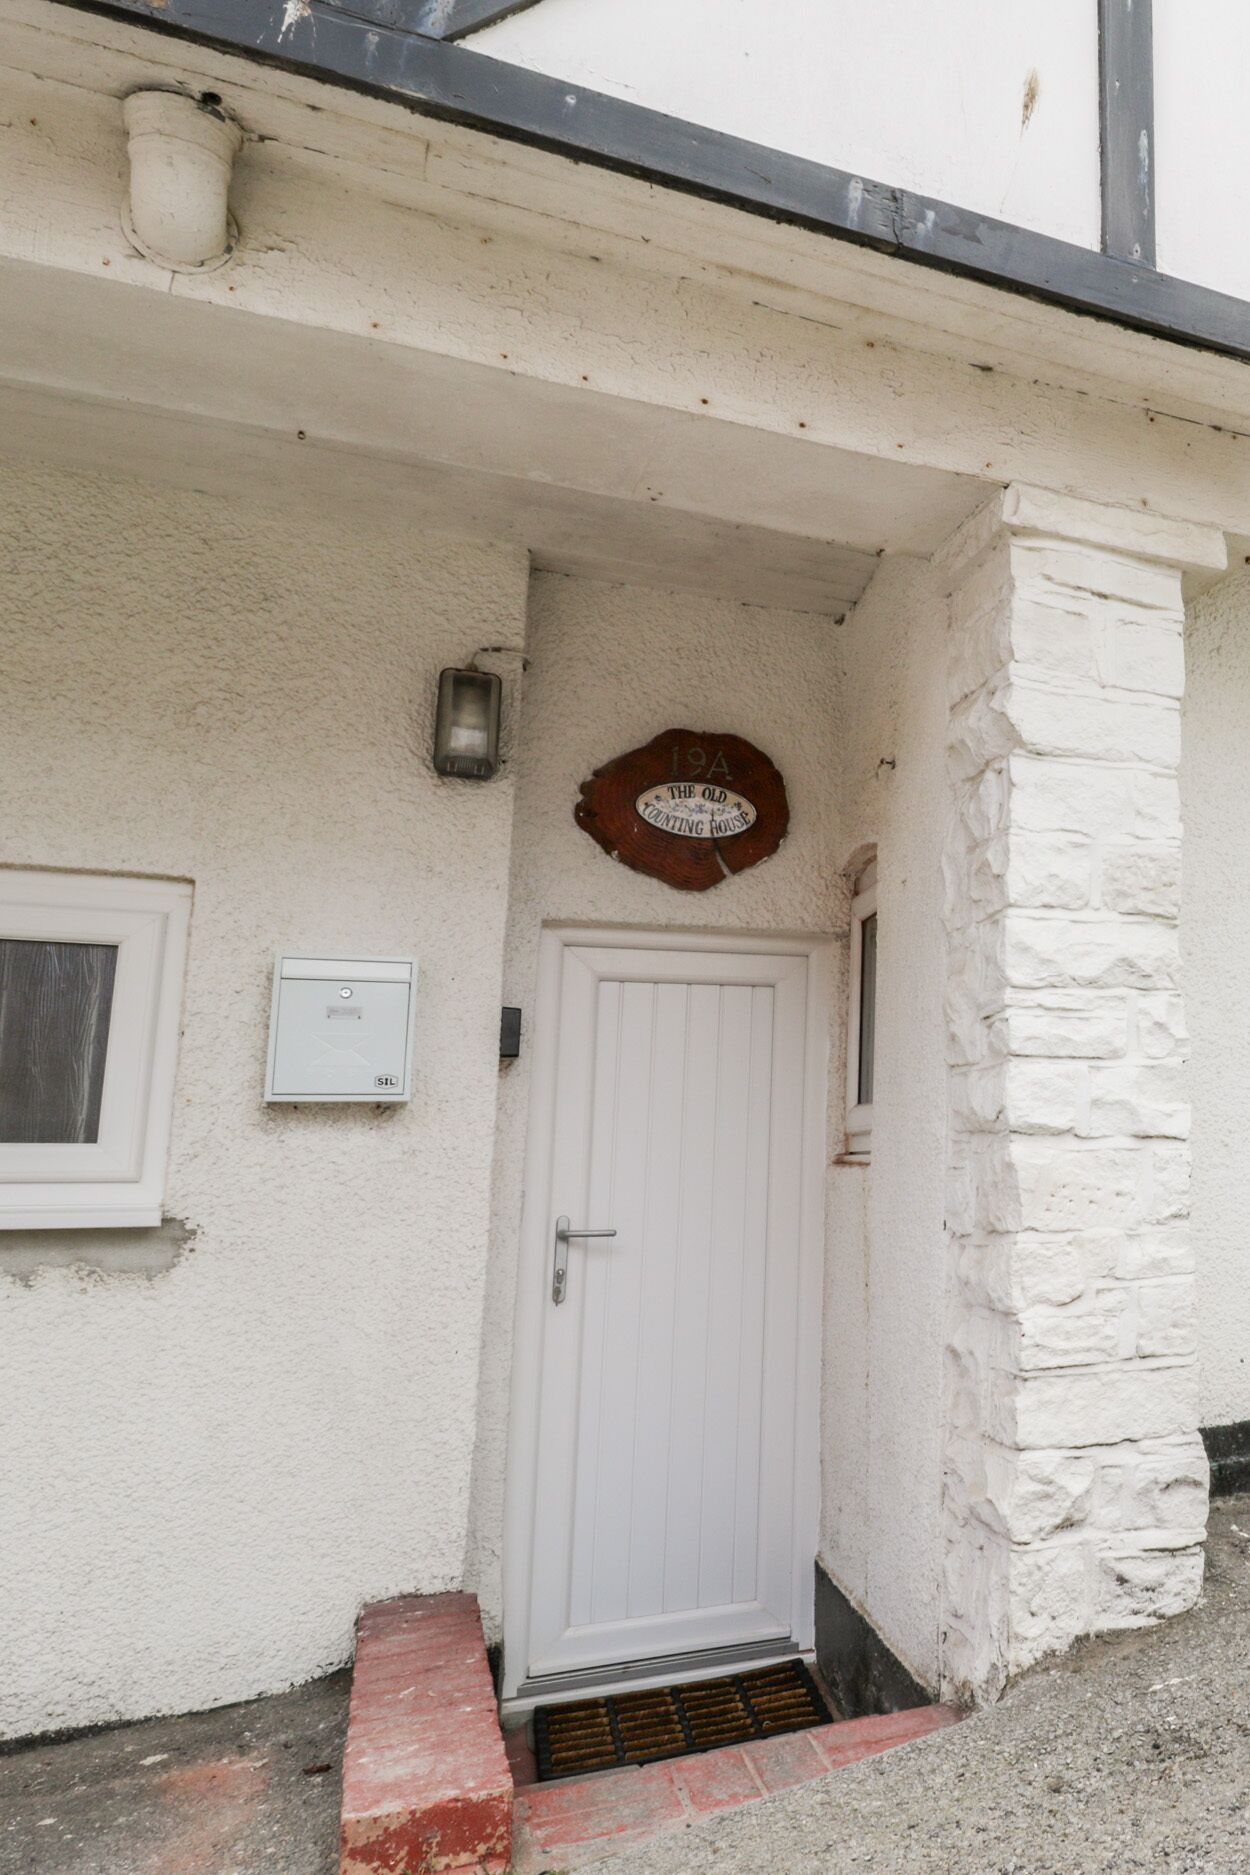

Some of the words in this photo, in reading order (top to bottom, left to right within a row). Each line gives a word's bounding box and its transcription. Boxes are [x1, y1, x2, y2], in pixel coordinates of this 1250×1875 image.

[671, 746, 733, 780] 19A
[667, 784, 696, 800] THE
[702, 786, 727, 804] OLD
[642, 804, 704, 836] COUNTING
[709, 811, 750, 836] HOUSE
[377, 1077, 396, 1086] SIL
